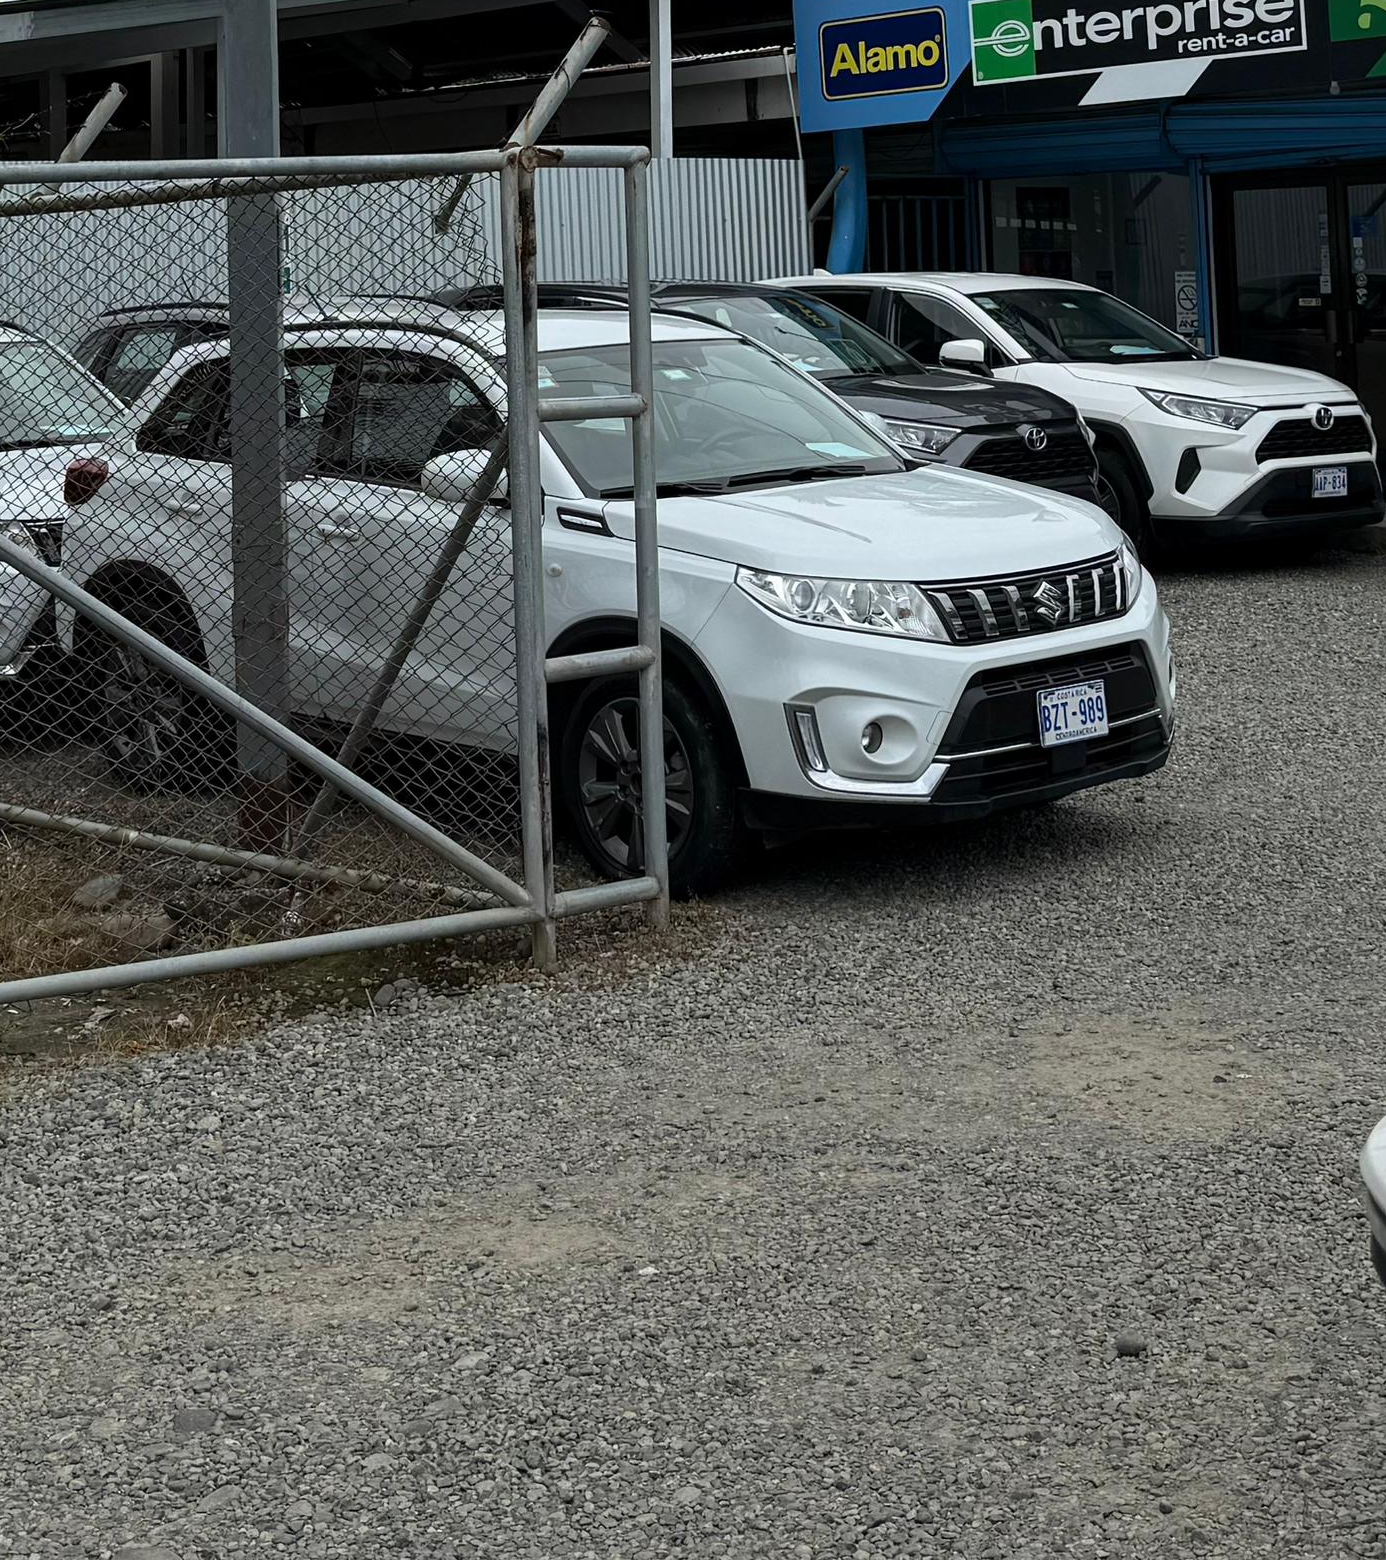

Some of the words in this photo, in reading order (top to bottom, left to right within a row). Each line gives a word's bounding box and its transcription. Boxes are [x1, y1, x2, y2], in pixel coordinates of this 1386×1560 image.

[1177, 25, 1296, 54] rent-a-car
[829, 40, 940, 78] Alamo
[1042, 695, 1105, 732] BZT-989
